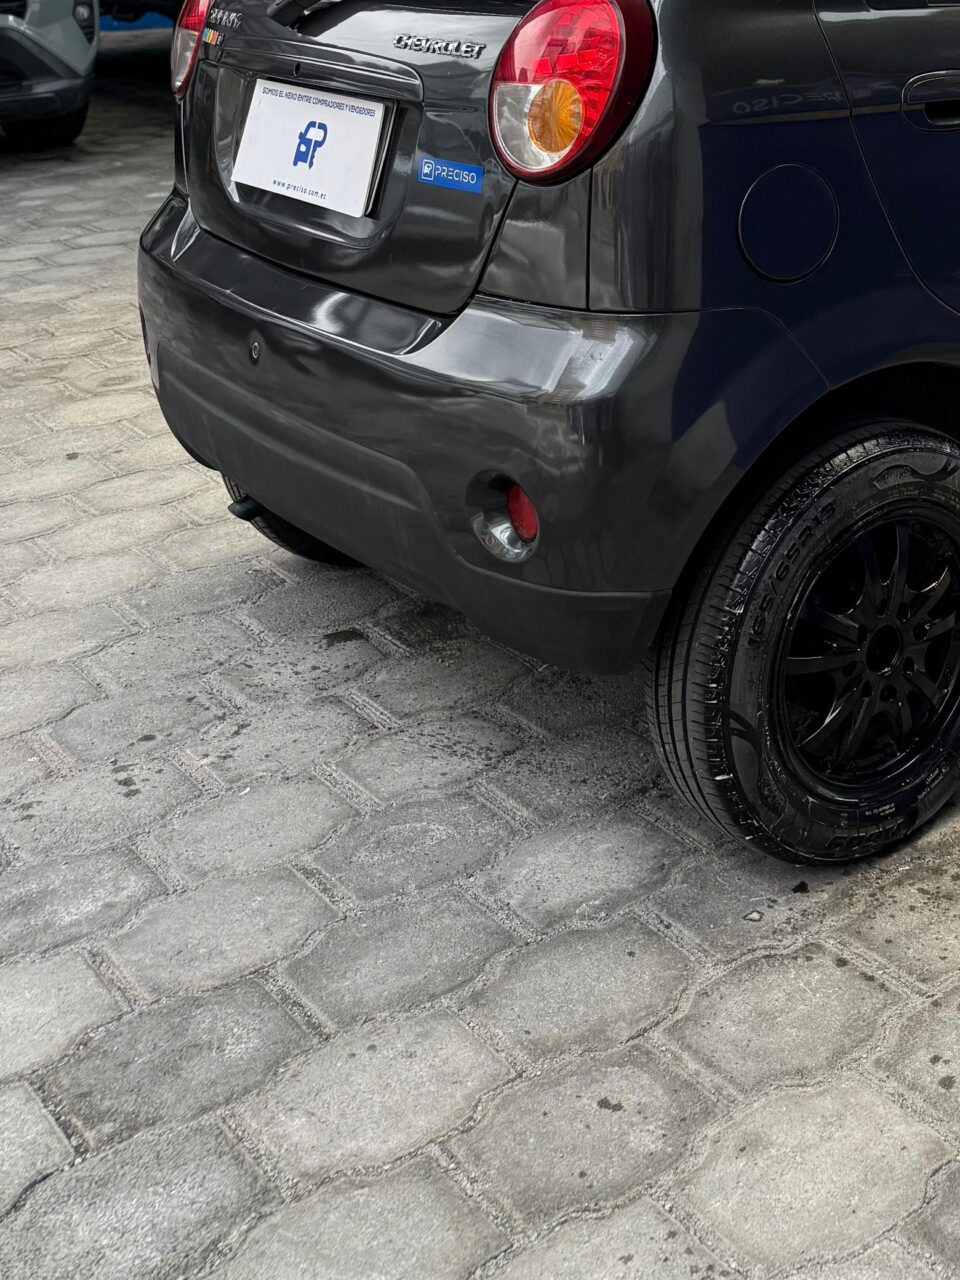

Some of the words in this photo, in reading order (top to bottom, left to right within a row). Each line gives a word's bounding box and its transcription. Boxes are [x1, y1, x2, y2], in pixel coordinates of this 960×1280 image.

[393, 34, 486, 59] CHEVROLET
[262, 87, 279, 97] SOMOS
[284, 91, 297, 100] NEXO
[297, 94, 312, 104] ENTRE
[312, 97, 345, 111] COMPRADORES
[435, 165, 477, 184] PRECISO
